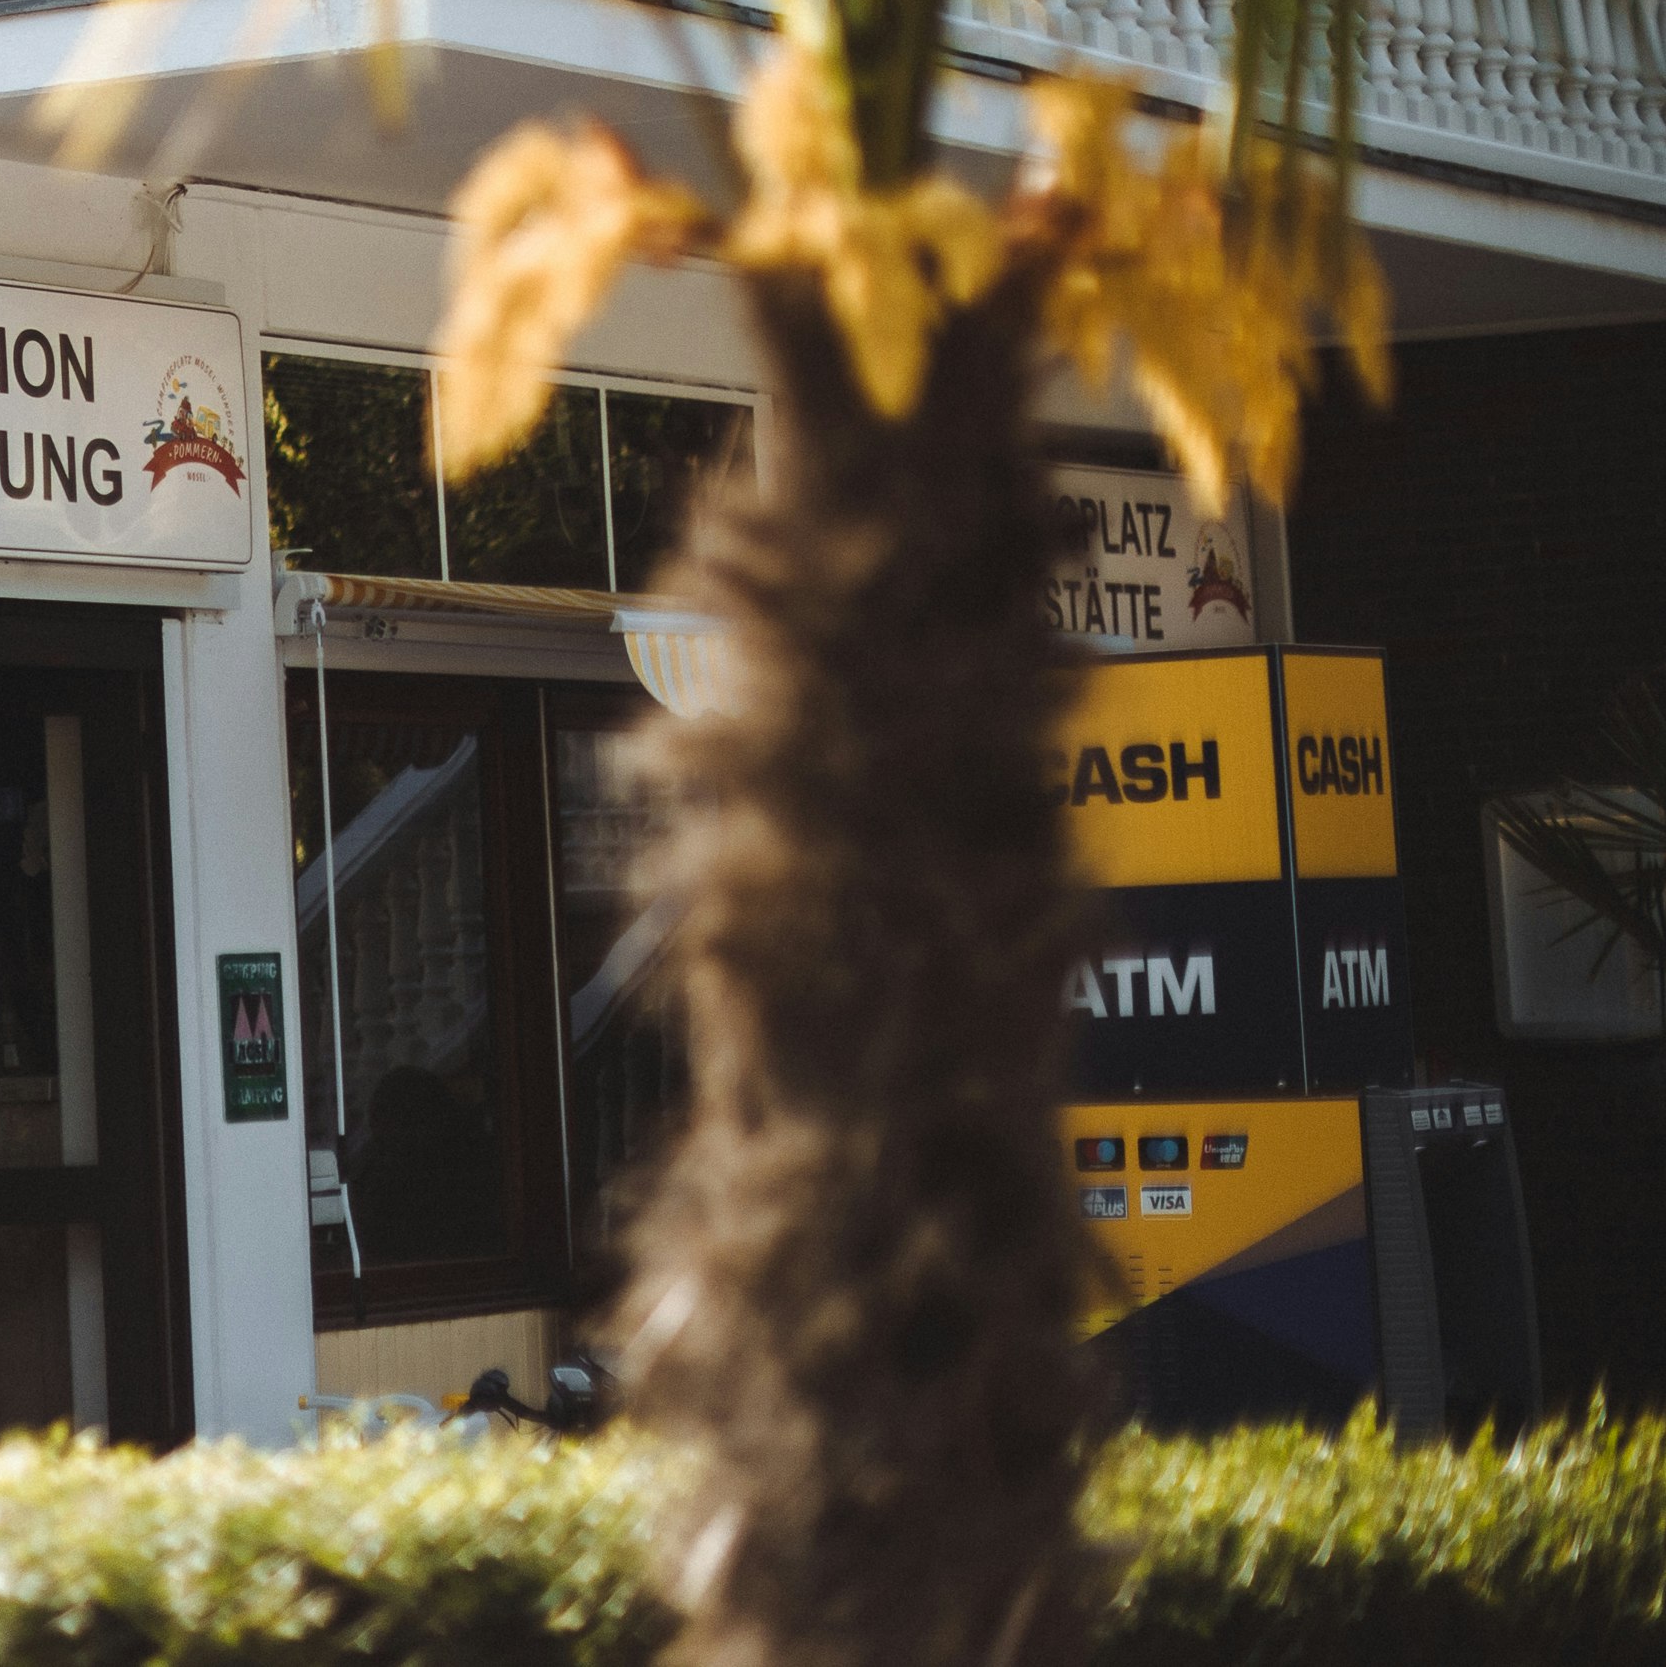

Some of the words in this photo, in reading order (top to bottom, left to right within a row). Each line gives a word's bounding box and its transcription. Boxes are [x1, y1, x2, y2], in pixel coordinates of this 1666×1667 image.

[156, 355, 193, 417] CAMPINGPLATZ
[195, 357, 216, 382] MOSEL
[217, 384, 234, 437] WUNDER
[173, 442, 220, 463] POMMERN
[186, 471, 207, 483] MOSEL
[1056, 495, 1176, 558] PLATZ
[1297, 735, 1384, 796] CASH
[1068, 954, 1216, 1018] ATM
[1322, 947, 1390, 1010] ATM
[228, 1086, 284, 1105] AMPING
[1094, 1201, 1124, 1216] PLUS
[1150, 1196, 1185, 1210] VISA
